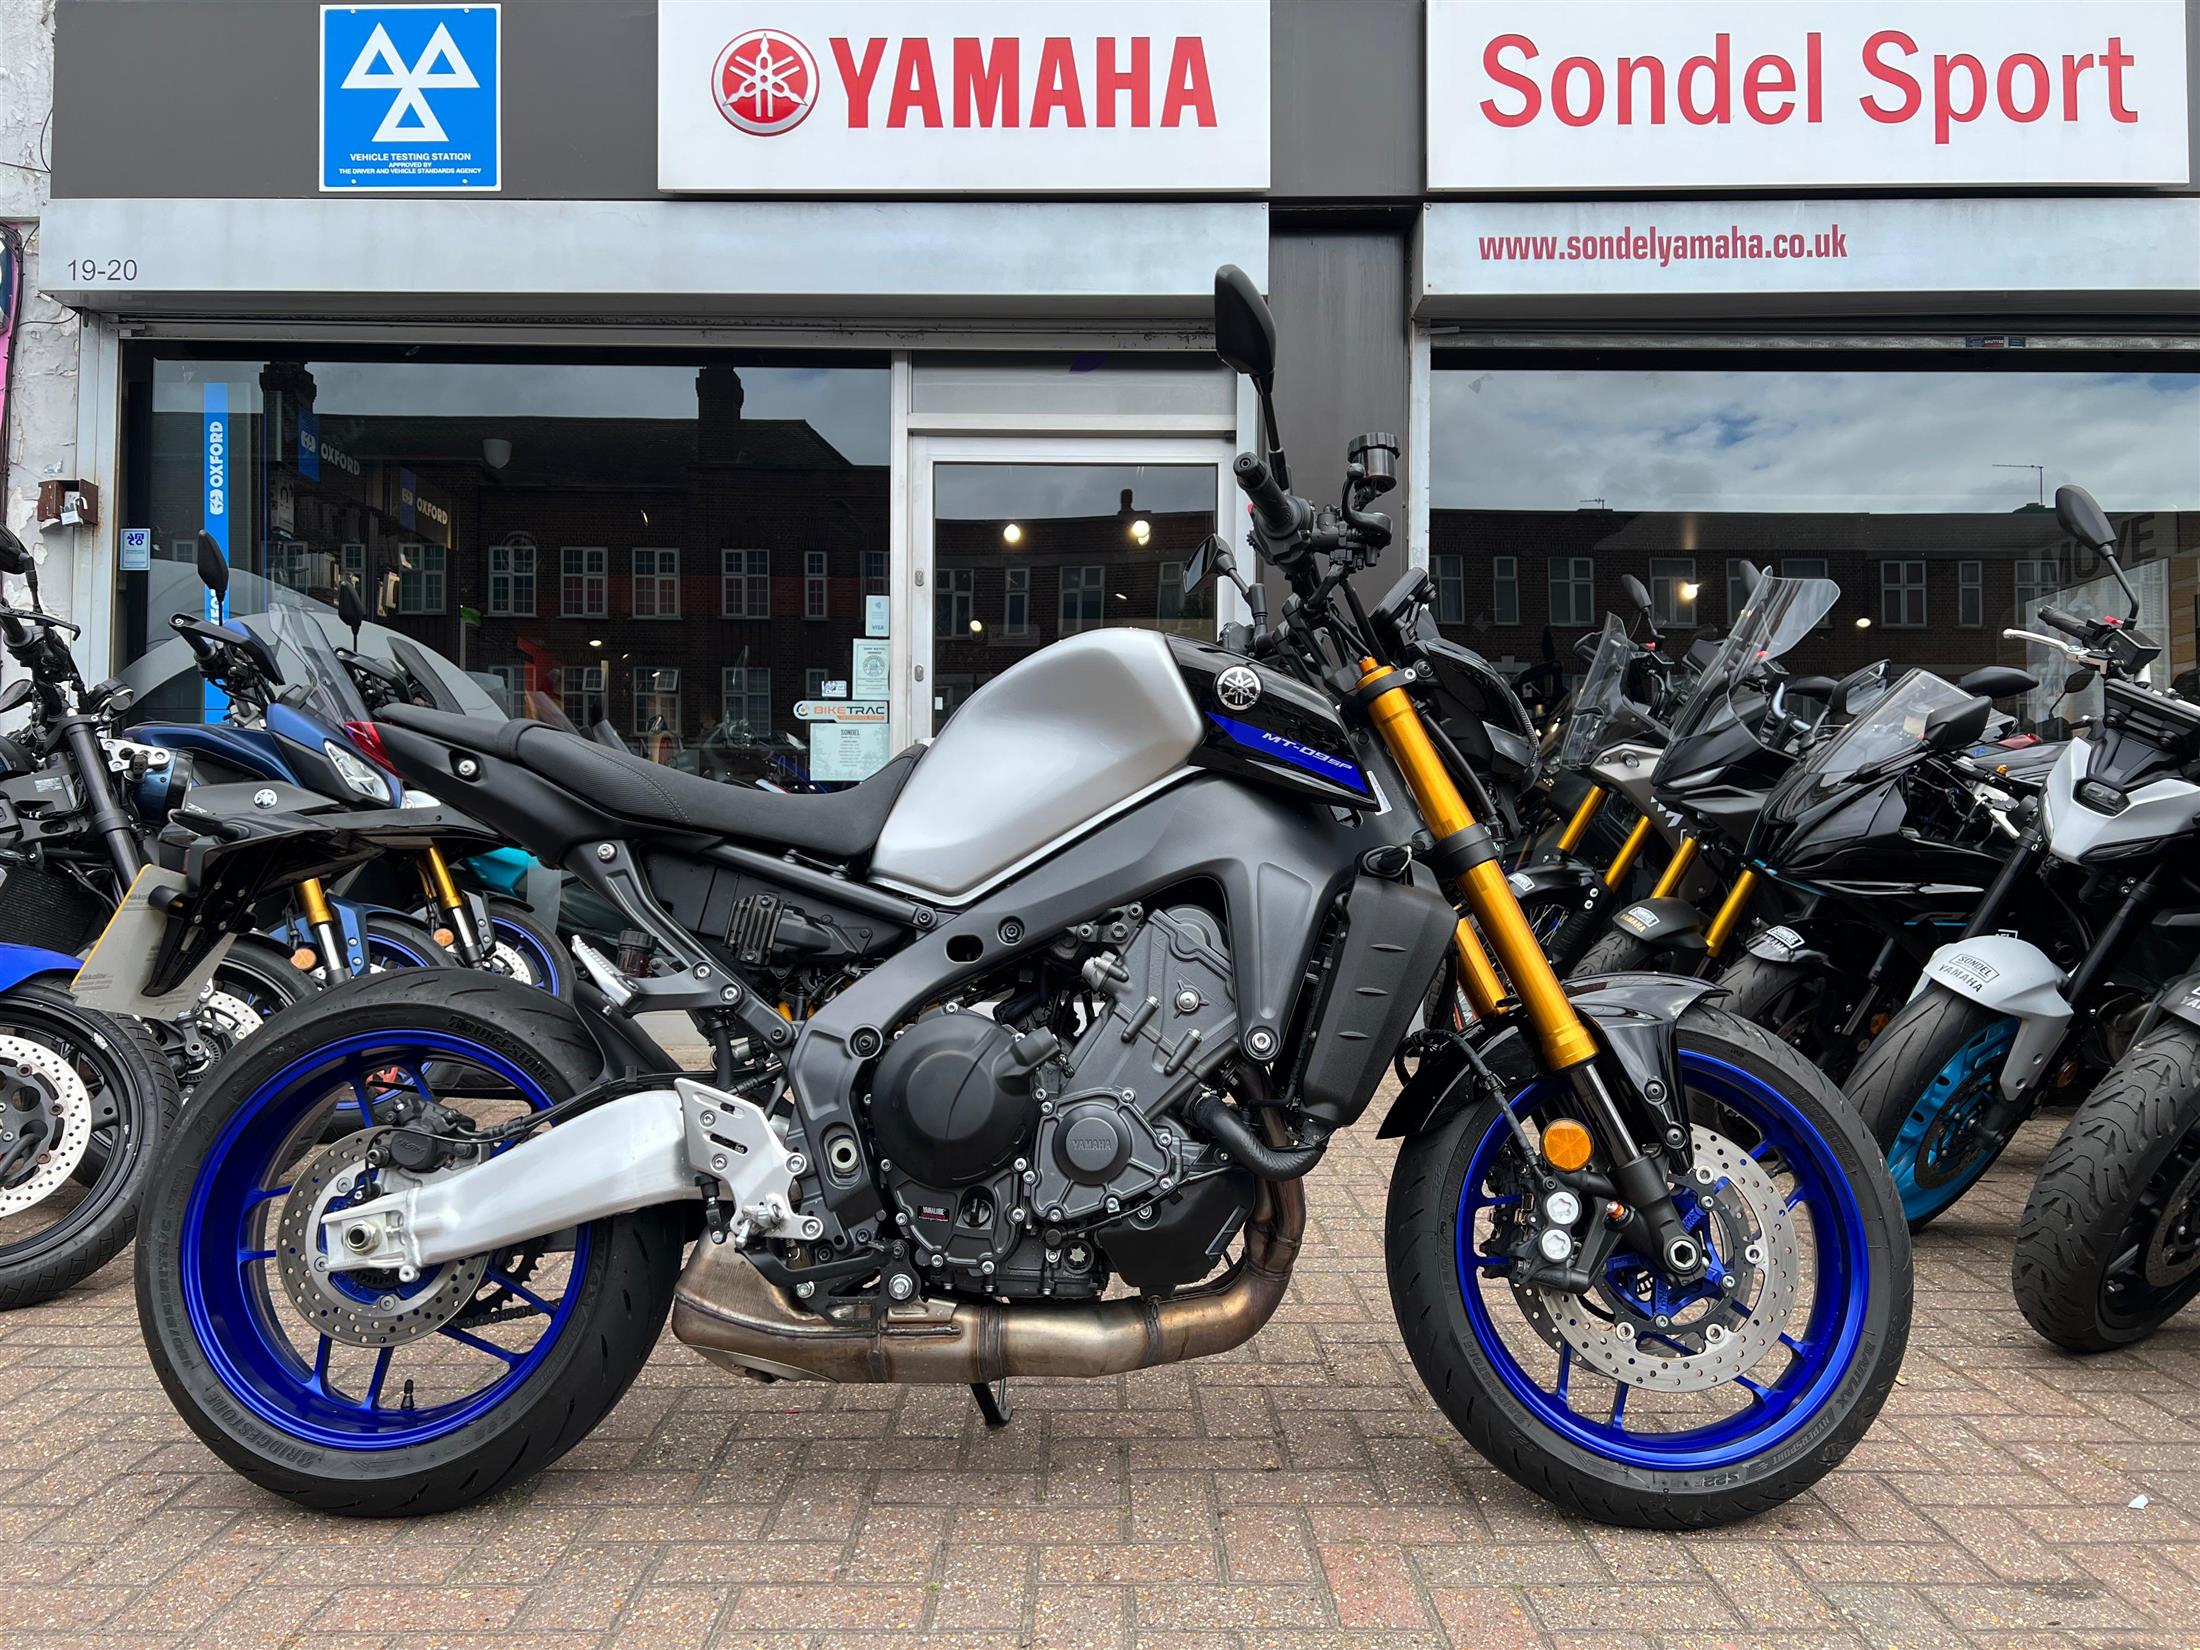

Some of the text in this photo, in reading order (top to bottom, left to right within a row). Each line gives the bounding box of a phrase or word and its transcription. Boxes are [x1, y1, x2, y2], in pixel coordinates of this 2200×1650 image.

[830, 36, 1218, 129] YAMAHA
[1480, 30, 2138, 145] Sondel Sport
[350, 153, 471, 161] VEHICLE TESTING STATION
[1479, 223, 1848, 267] www.sondelyamaha.co.uk
[68, 259, 138, 281] 19-20
[210, 421, 224, 488] OXFORD
[320, 442, 361, 476] OXFORD
[416, 497, 448, 525] OXFORD
[814, 706, 885, 715] BIKETRAC
[1938, 964, 1983, 993] YAMAHA
[1958, 956, 1992, 977] SONDEL
[1072, 1139, 1112, 1151] YAMAHA
[204, 1391, 319, 1469] BRIDGESTONE
